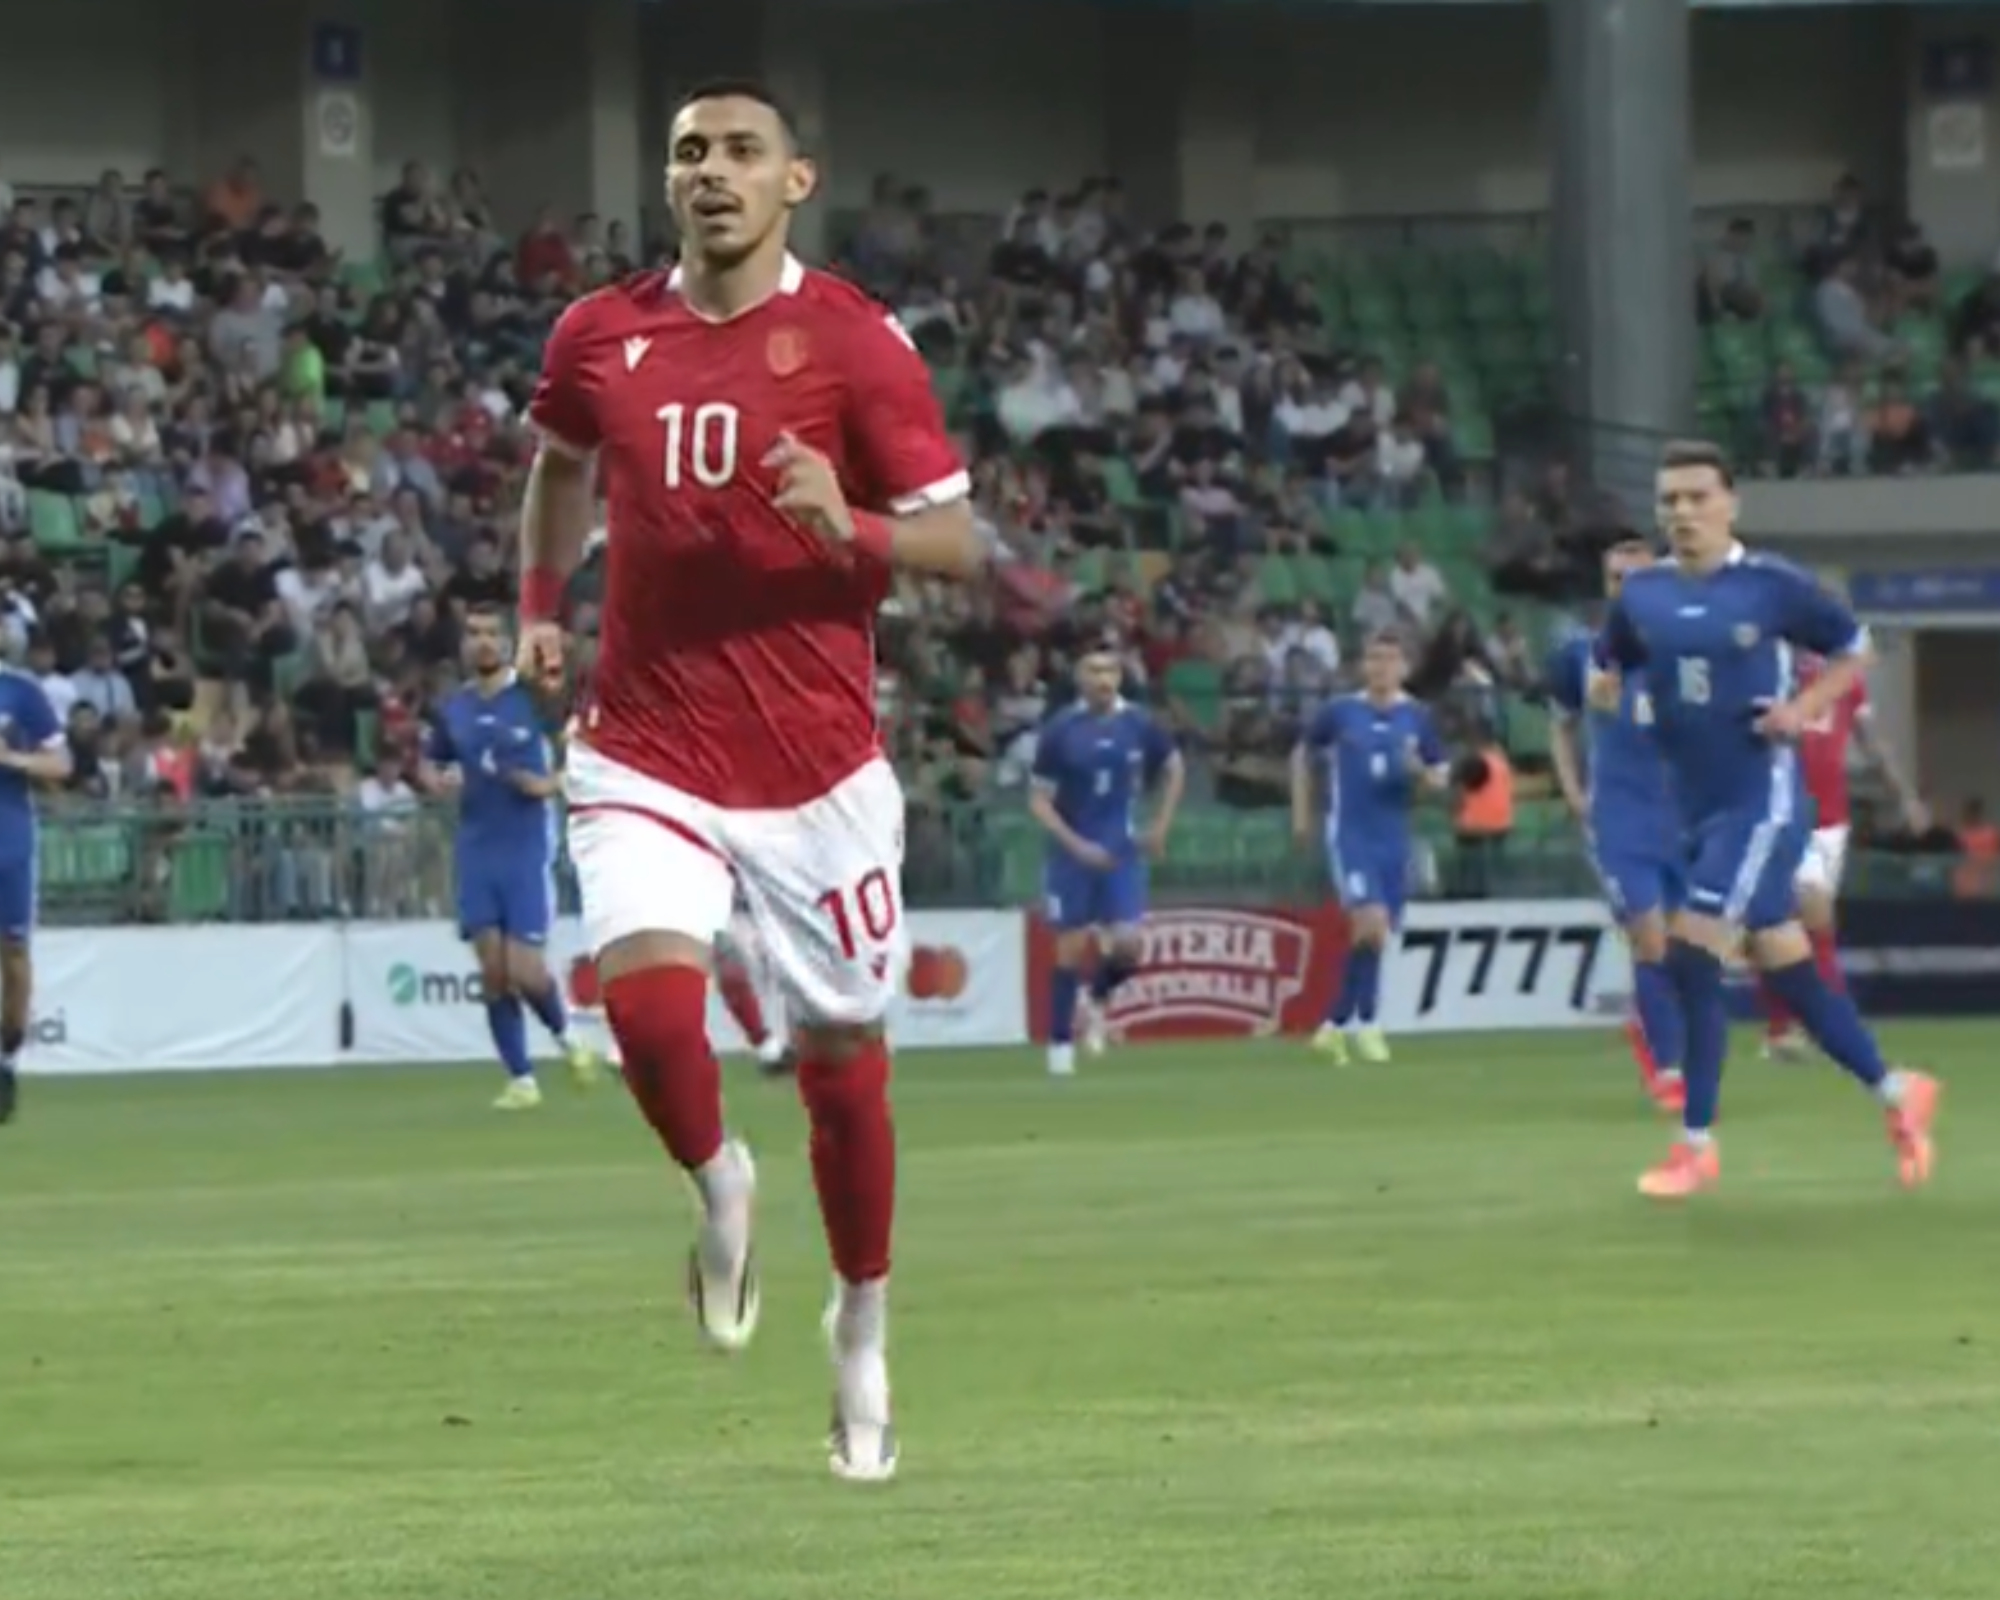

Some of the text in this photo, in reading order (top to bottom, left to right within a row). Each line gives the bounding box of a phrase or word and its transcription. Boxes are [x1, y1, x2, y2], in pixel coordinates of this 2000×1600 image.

[655, 401, 739, 488] 10
[816, 867, 895, 960] 10
[1401, 926, 1603, 1017] 7777
